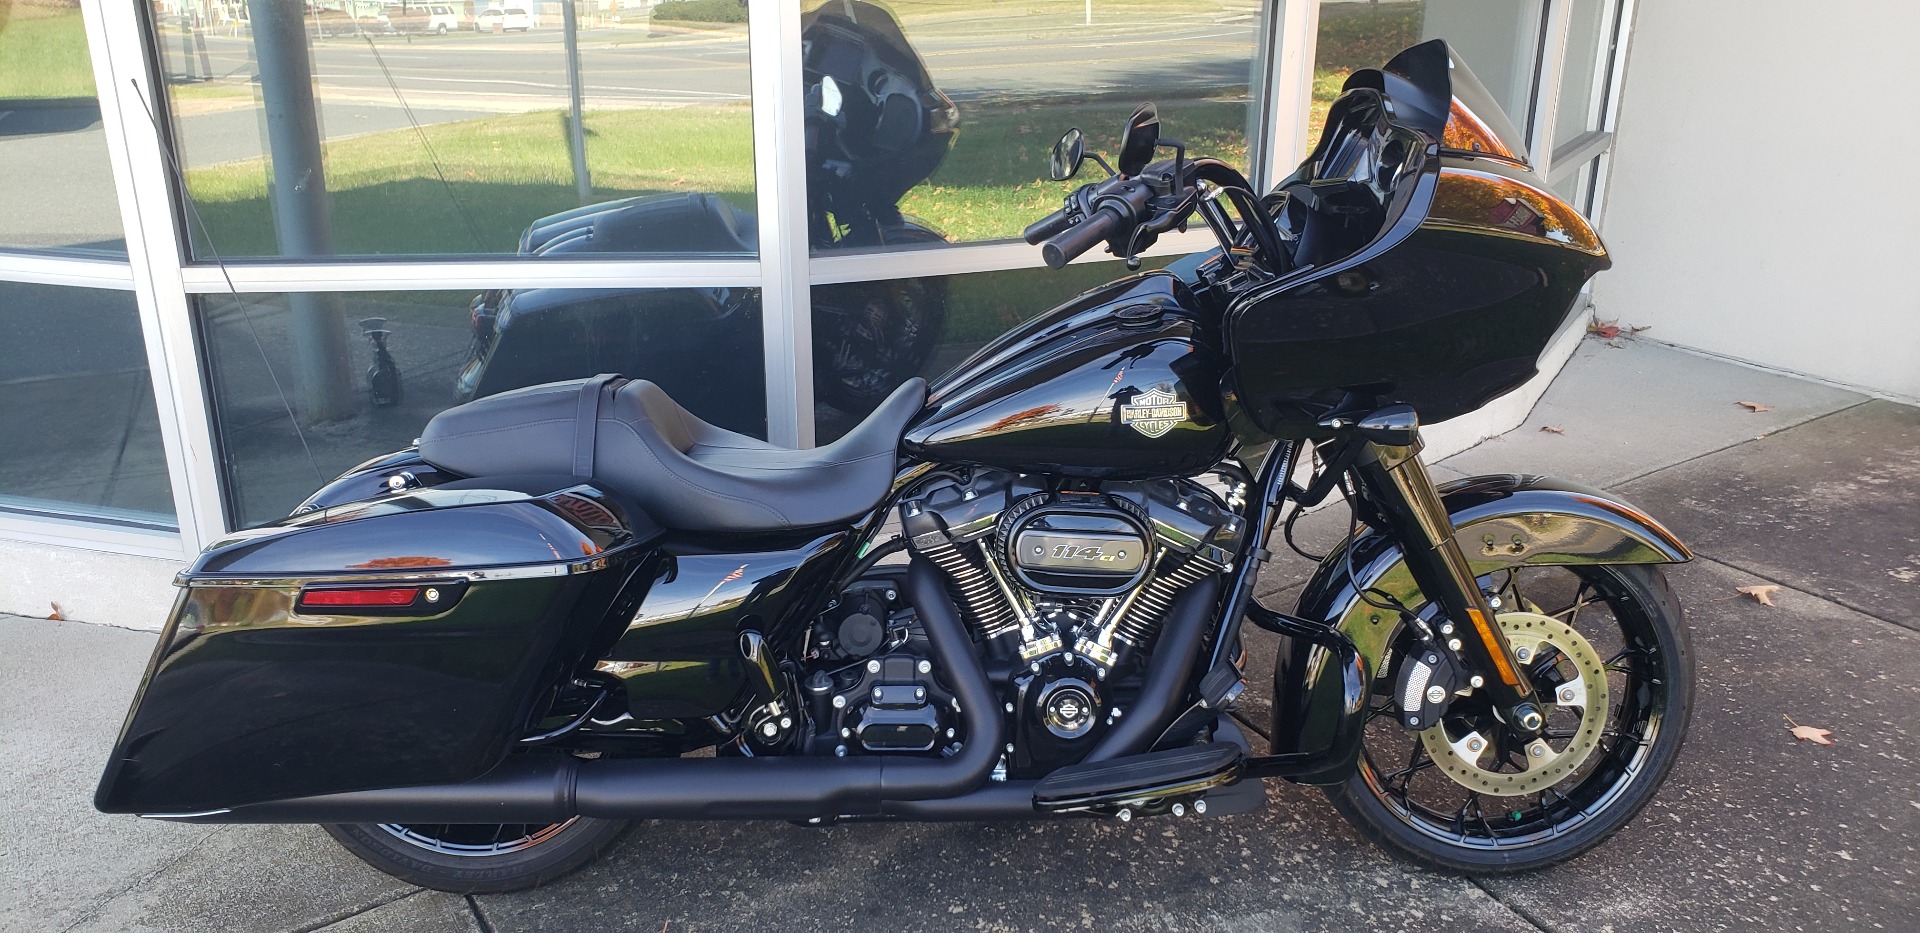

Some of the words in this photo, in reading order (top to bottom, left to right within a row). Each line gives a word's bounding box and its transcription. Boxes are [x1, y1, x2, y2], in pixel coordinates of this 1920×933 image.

[1140, 395, 1169, 406] MOTOR
[1127, 406, 1182, 419] HARLEY-DAVIDSON
[1140, 421, 1169, 432] CYCLES
